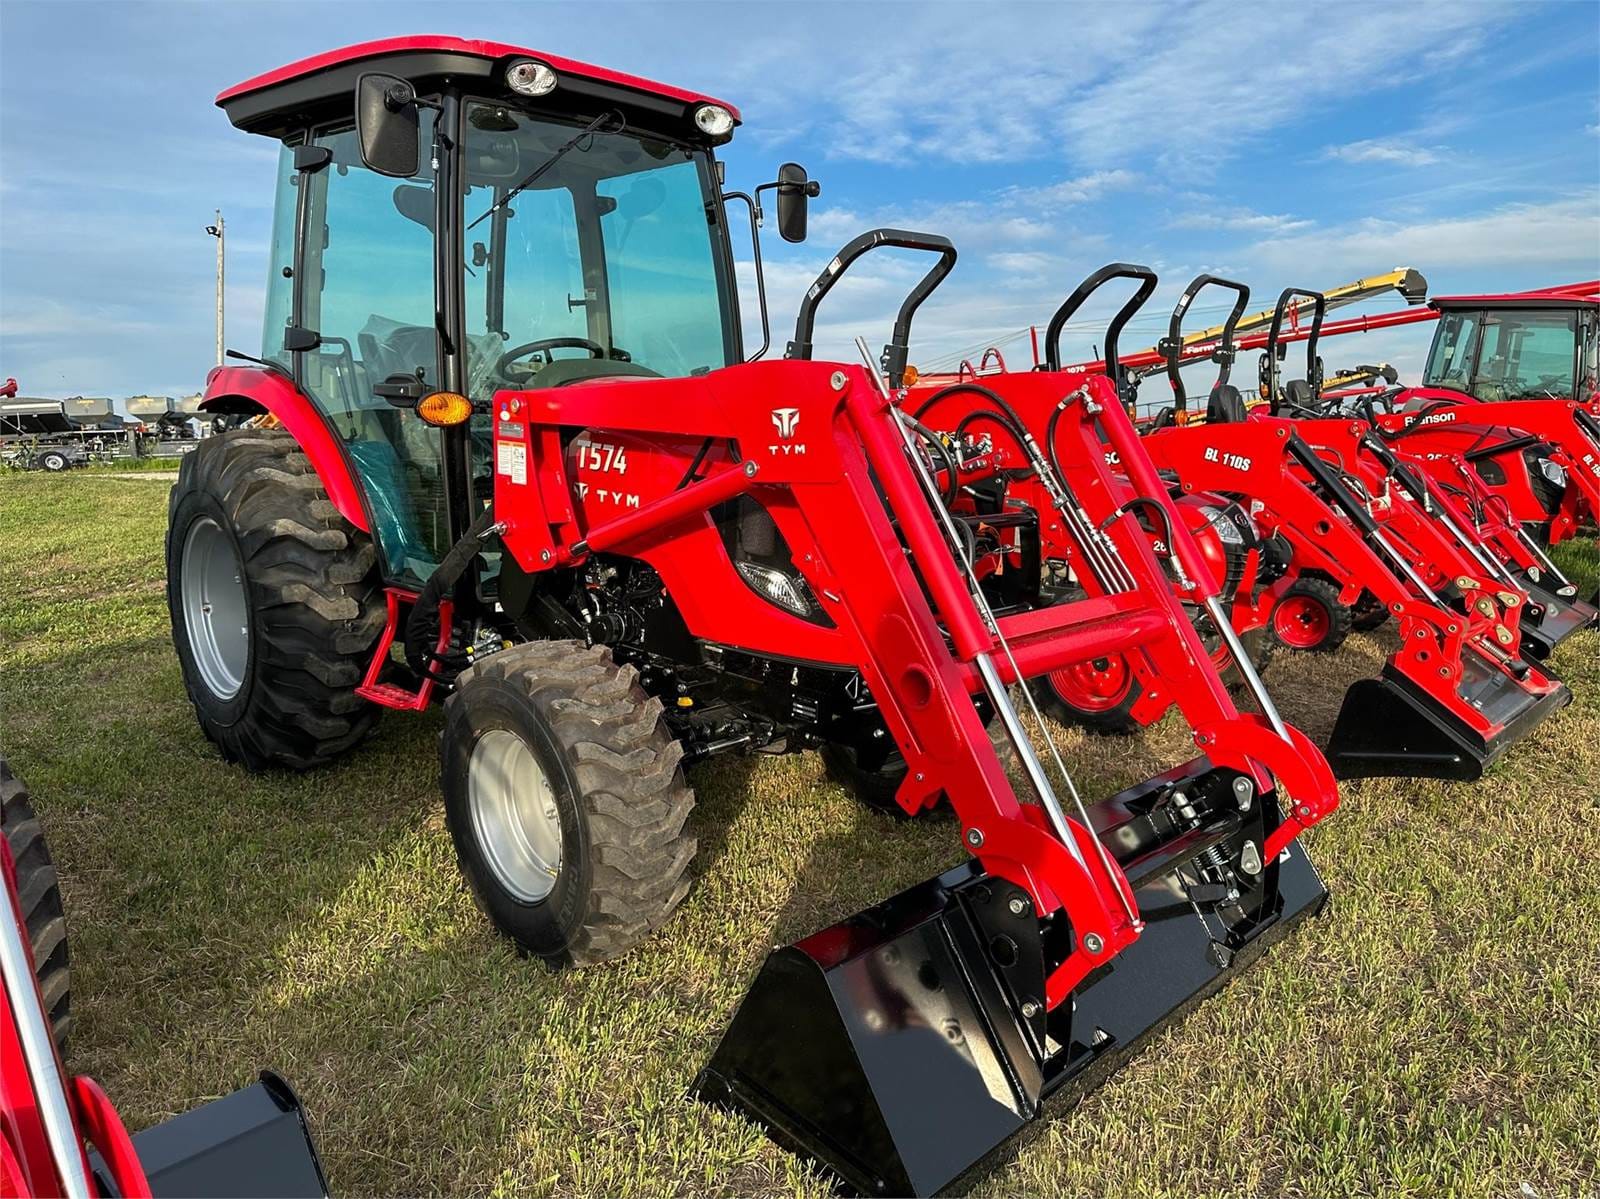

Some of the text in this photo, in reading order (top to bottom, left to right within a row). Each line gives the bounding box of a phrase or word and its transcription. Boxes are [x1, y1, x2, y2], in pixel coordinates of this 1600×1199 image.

[577, 439, 627, 475] T574
[768, 444, 806, 456] TYM
[1204, 447, 1252, 472] BL 110S
[596, 488, 640, 509] TYM
